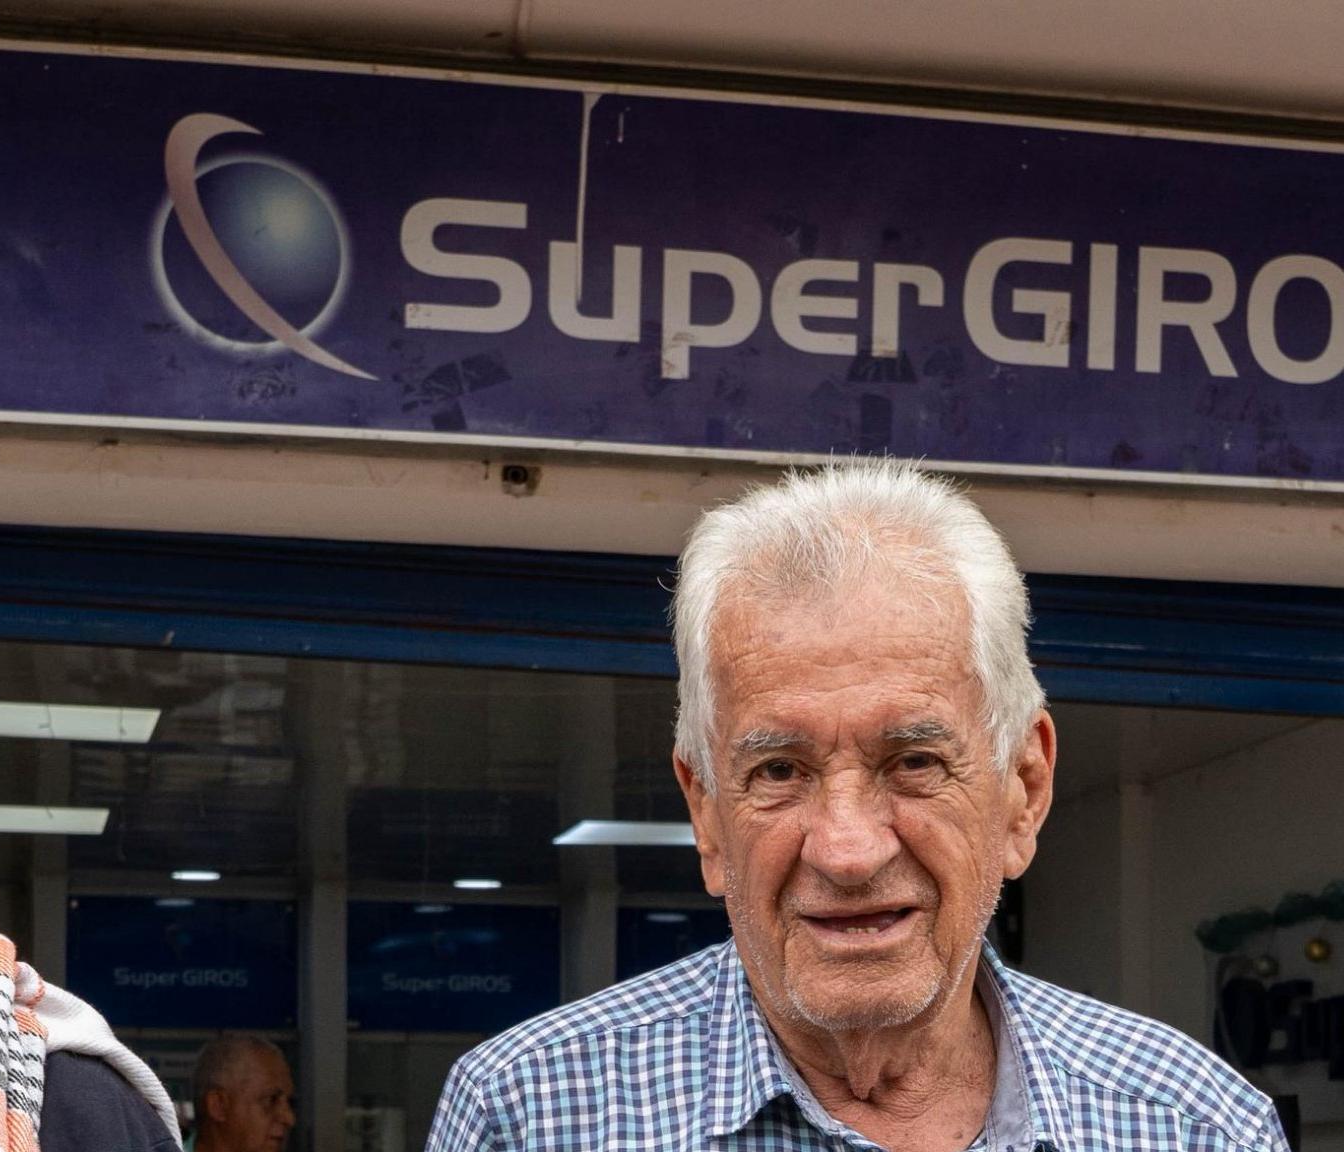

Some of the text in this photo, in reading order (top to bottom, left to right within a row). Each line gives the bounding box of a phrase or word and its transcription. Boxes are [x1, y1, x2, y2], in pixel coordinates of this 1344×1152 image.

[113, 966, 248, 990] Super GIROS
[382, 971, 513, 995] Super GIROS
